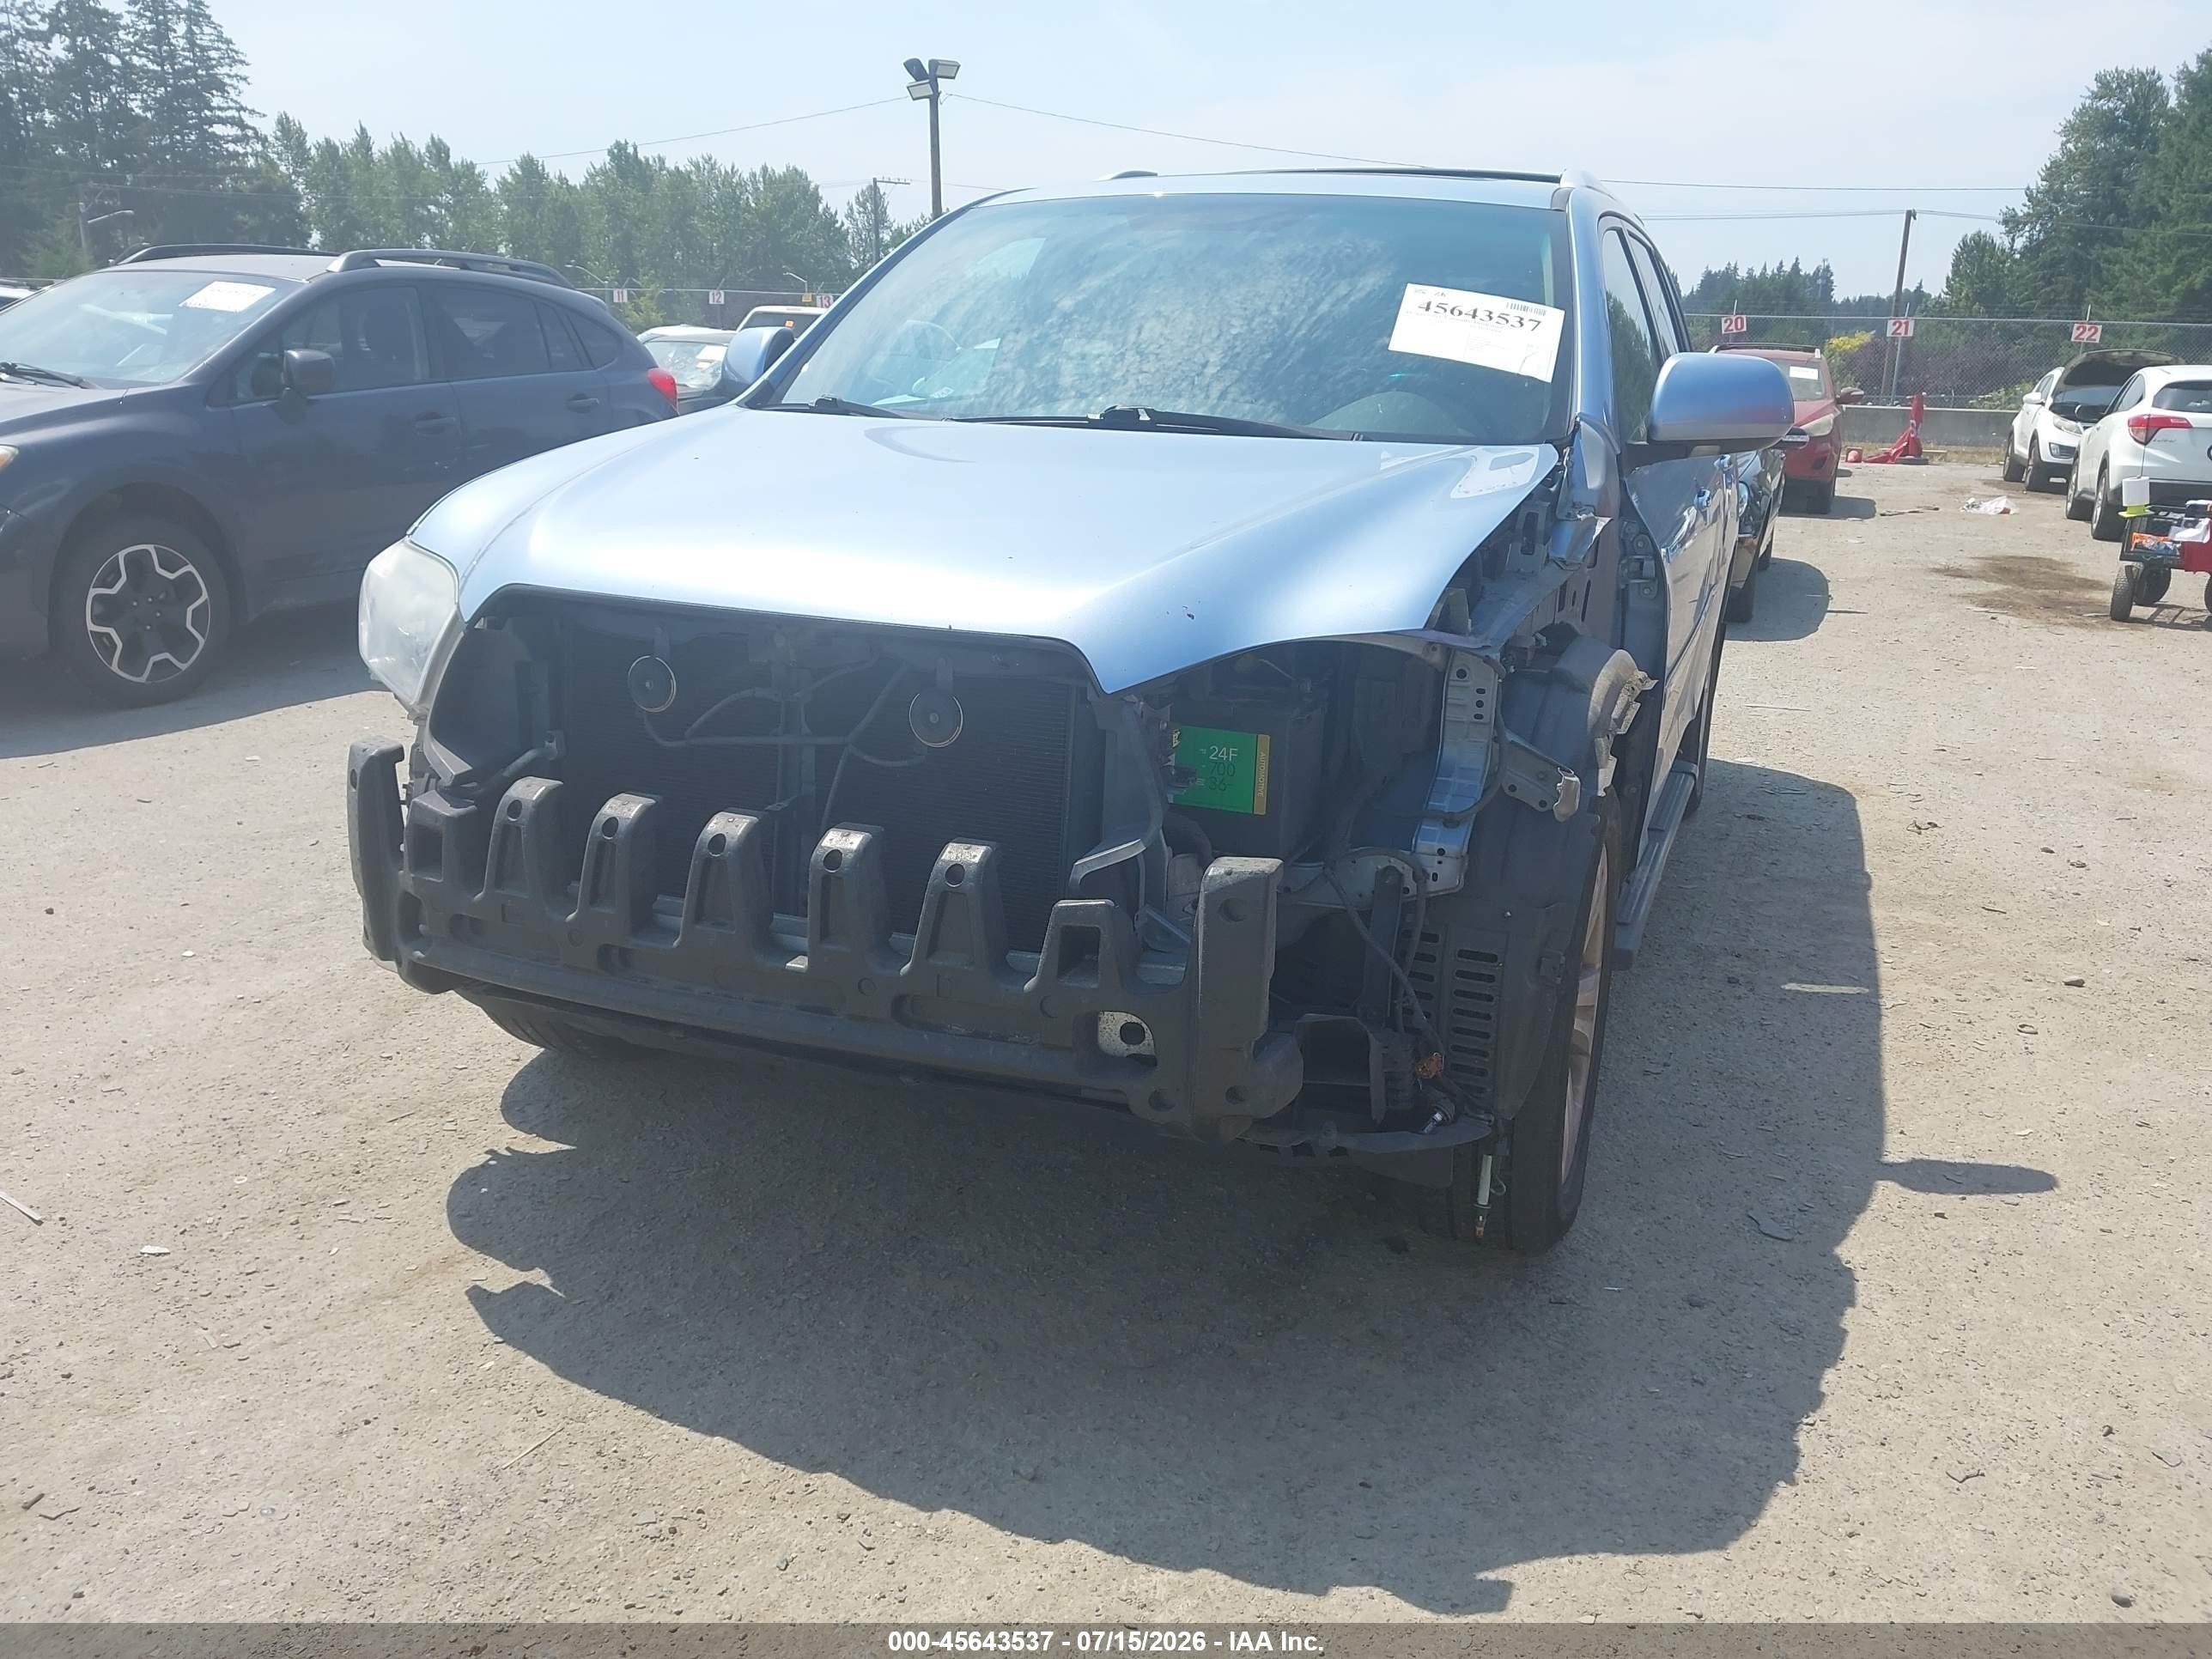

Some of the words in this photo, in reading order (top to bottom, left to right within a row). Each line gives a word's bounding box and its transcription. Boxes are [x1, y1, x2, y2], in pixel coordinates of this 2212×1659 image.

[617, 290, 624, 302] 11
[712, 291, 722, 303] 12
[819, 295, 831, 308] 13
[1418, 300, 1542, 332] 45643537
[1723, 316, 1745, 332] 20
[1891, 319, 1911, 336] 21
[2074, 325, 2099, 342] 22
[1208, 745, 1238, 762] 24F
[1257, 751, 1267, 798] AUTOMOTIVE
